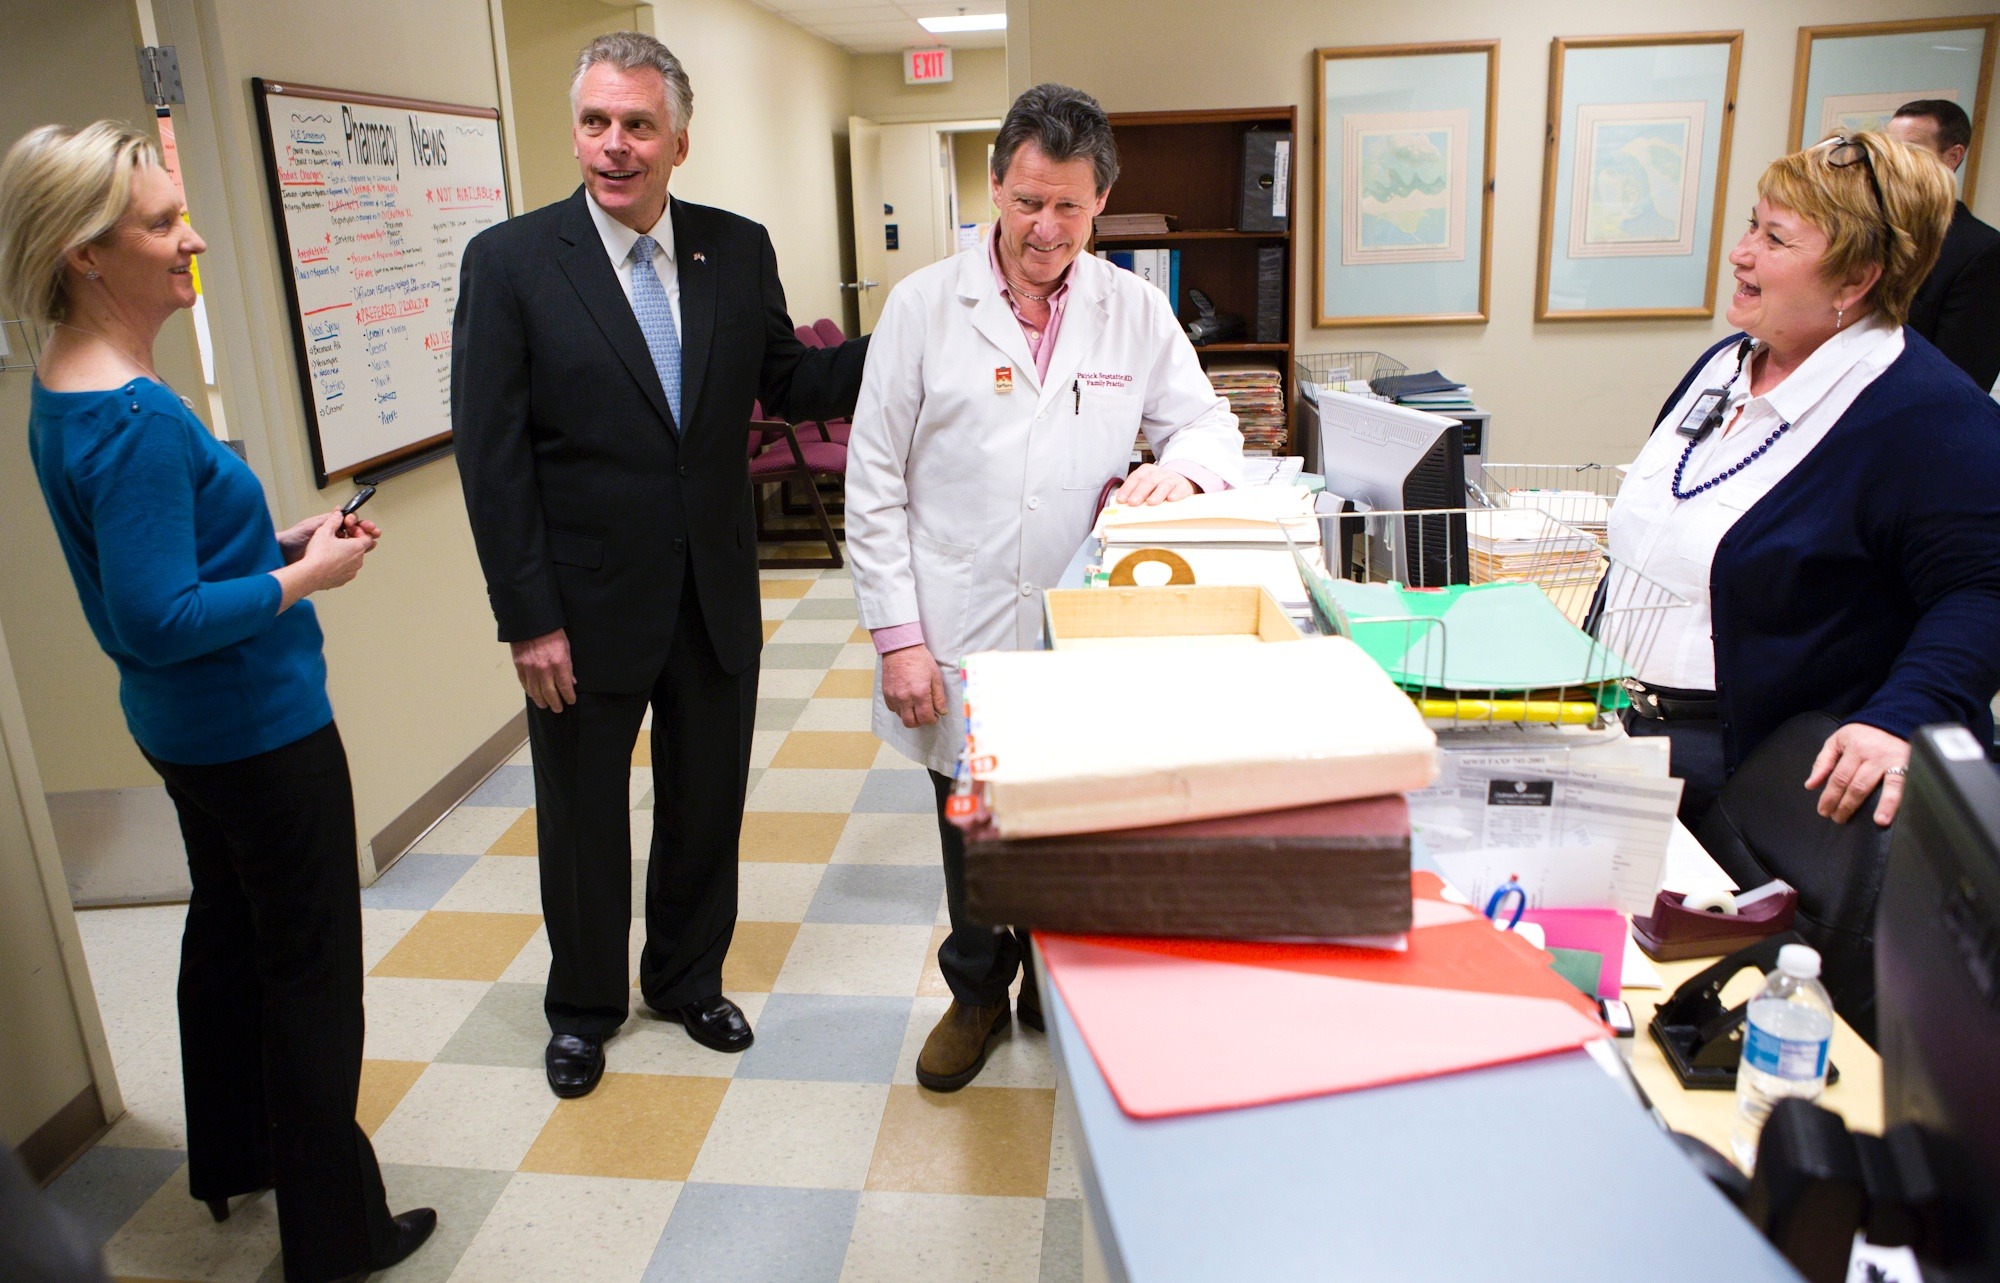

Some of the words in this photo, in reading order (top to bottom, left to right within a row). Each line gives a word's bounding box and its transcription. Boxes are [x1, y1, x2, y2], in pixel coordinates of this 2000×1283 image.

[912, 51, 945, 79] EXIT
[341, 104, 399, 181] Pharmacy
[408, 114, 447, 166] News
[436, 186, 453, 203] NOT
[456, 186, 495, 202] AVAILABLE
[360, 303, 397, 322] PREFERRED
[1077, 372, 1098, 380] Patrick
[1086, 380, 1105, 388] Family
